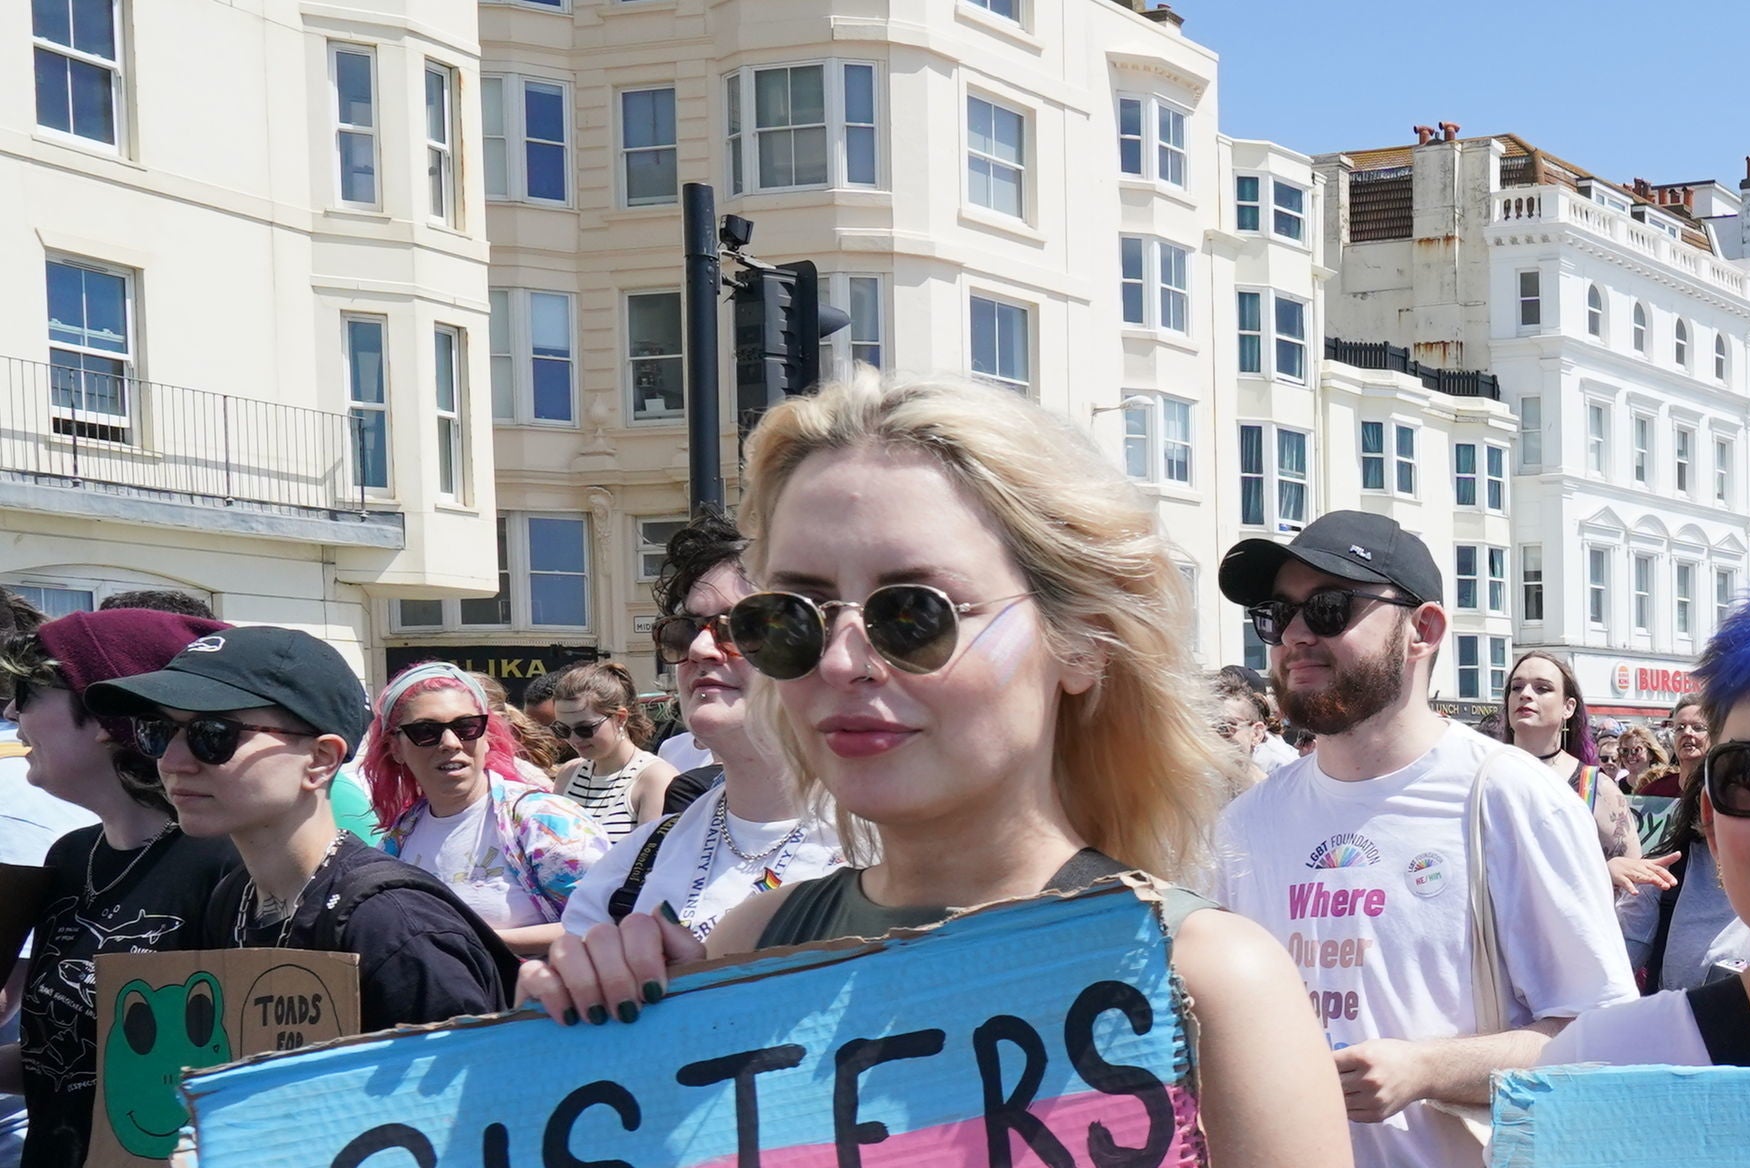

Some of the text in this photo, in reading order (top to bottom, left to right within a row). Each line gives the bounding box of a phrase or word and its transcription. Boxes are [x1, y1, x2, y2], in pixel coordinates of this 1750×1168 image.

[1305, 832, 1381, 868] LGBT FOUNDATION
[682, 876, 706, 918] WINS
[1289, 882, 1386, 920] Where
[1288, 932, 1373, 969] Queer
[254, 993, 322, 1027] TOADS
[1304, 981, 1359, 1029] ope
[276, 1031, 304, 1050] FOR
